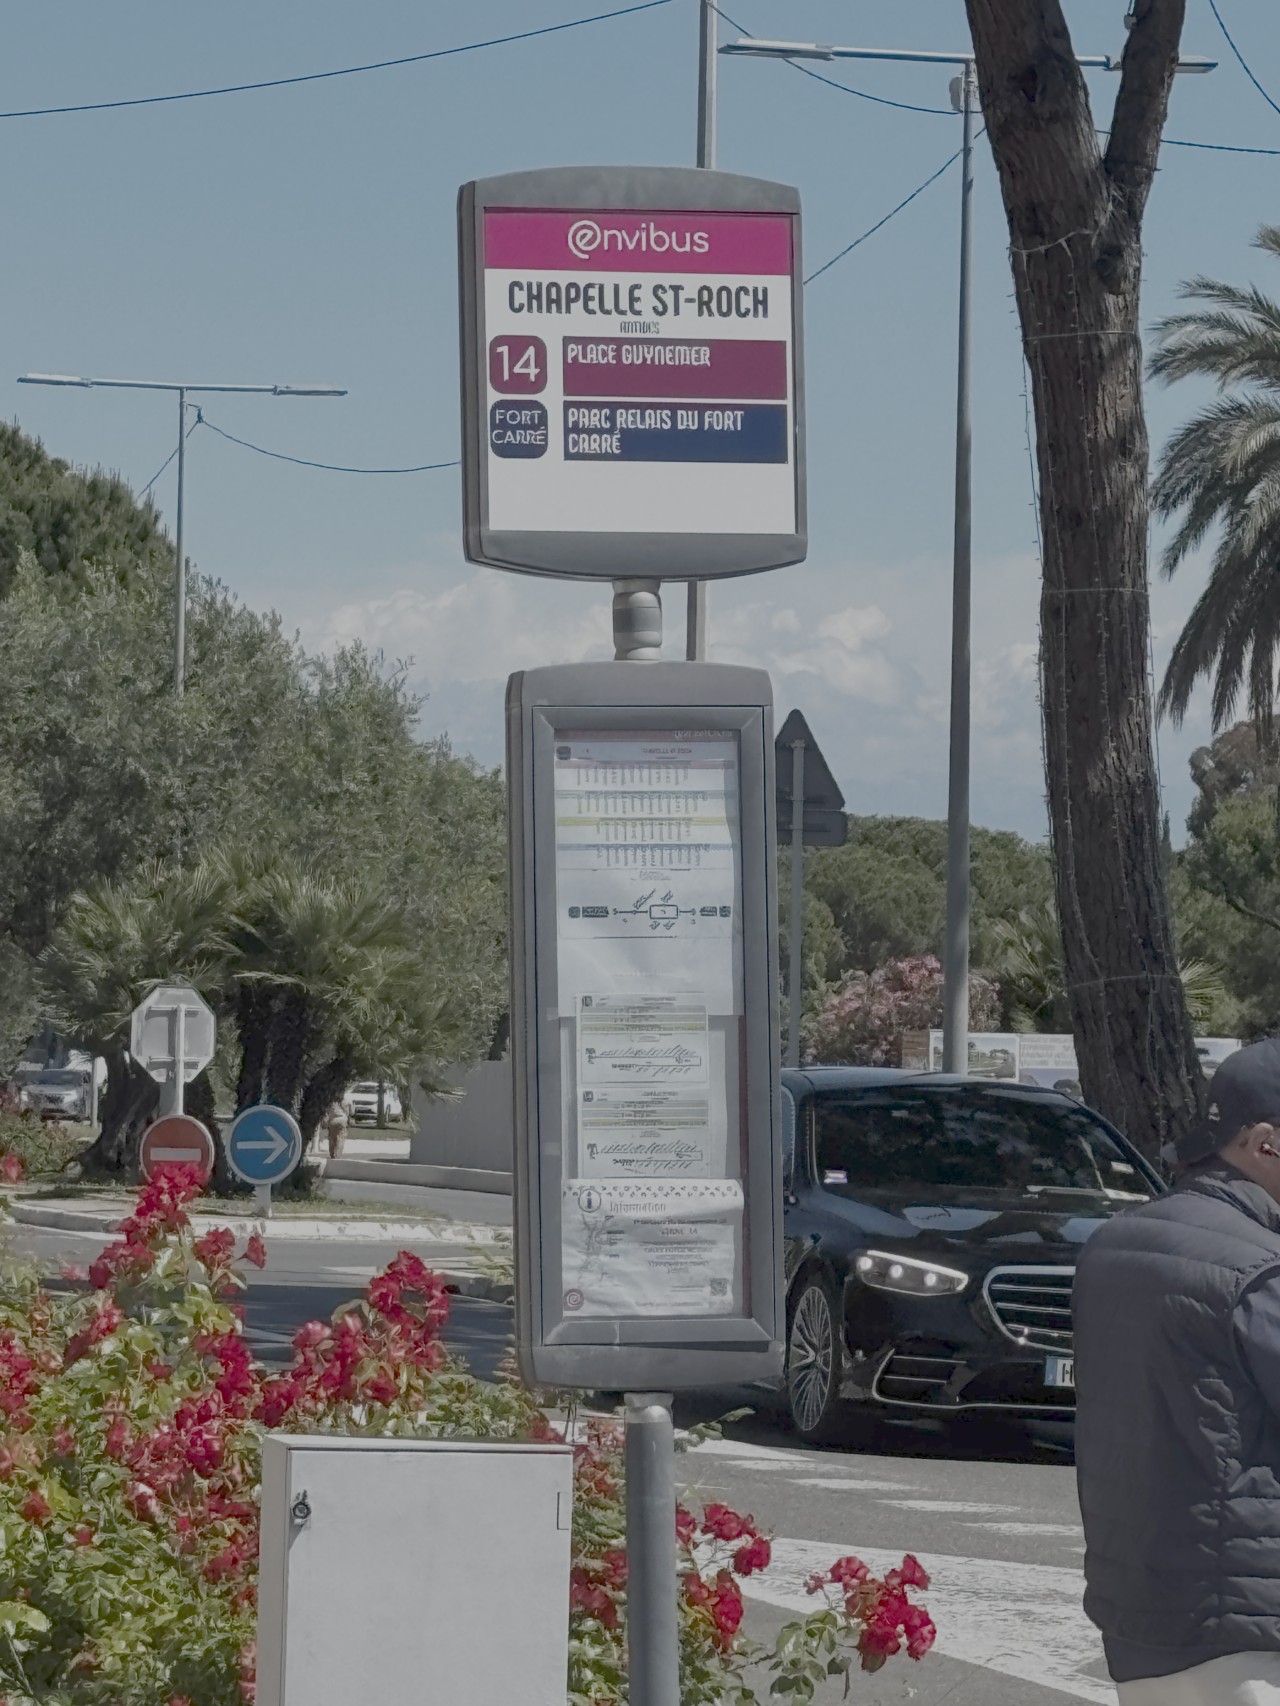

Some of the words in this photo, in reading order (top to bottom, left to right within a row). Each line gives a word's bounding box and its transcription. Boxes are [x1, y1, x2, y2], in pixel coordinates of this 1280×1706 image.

[508, 280, 643, 316] CHAPELLE
[651, 283, 769, 318] ST-ROCH
[495, 344, 541, 383] 14
[566, 343, 617, 365] PLACE
[621, 344, 711, 367] GUYNEMER
[495, 409, 542, 425] FORT
[567, 407, 610, 429] PARC
[615, 409, 671, 431] RELAIS
[677, 410, 699, 430] DU
[703, 411, 744, 431] FORT
[491, 426, 547, 445] CARRÉ
[567, 431, 622, 454] CARRÉ
